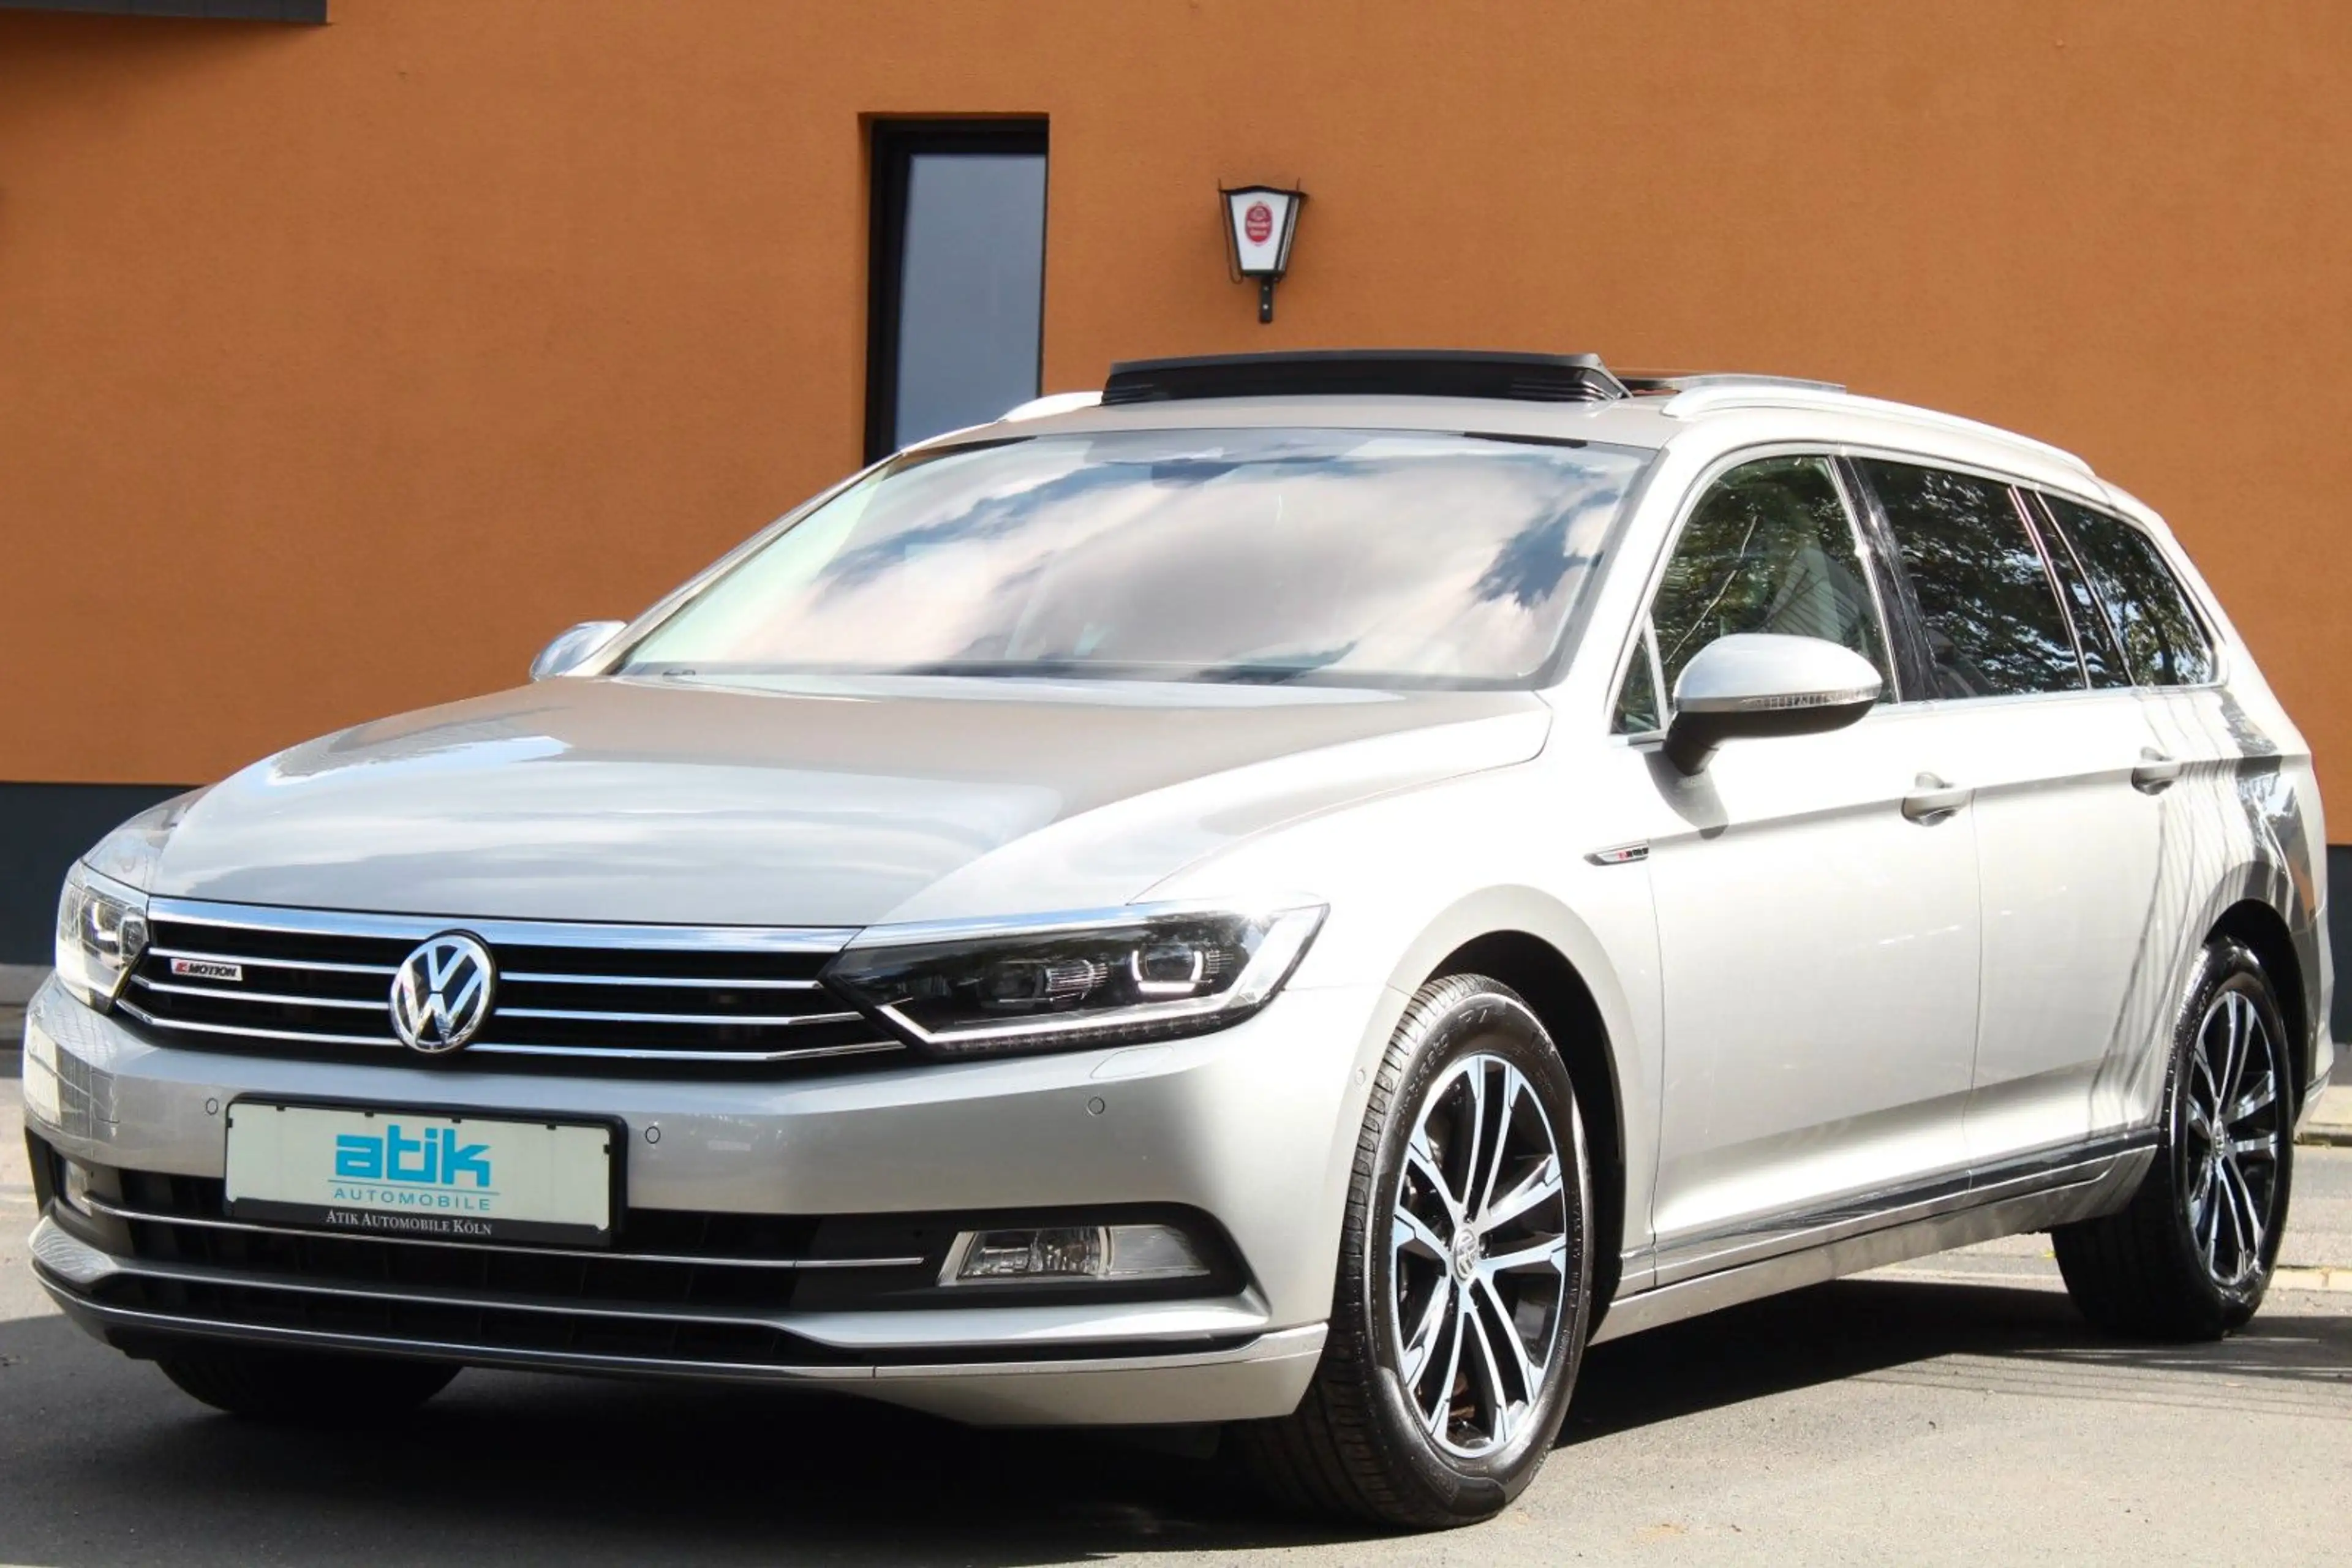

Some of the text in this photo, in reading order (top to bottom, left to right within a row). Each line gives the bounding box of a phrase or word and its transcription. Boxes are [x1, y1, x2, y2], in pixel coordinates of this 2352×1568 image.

[336, 1124, 491, 1187] atik
[334, 1187, 491, 1211] AUTOMOBILE
[326, 1208, 492, 1235] ATIK AUTOMOBILE KÖLN
